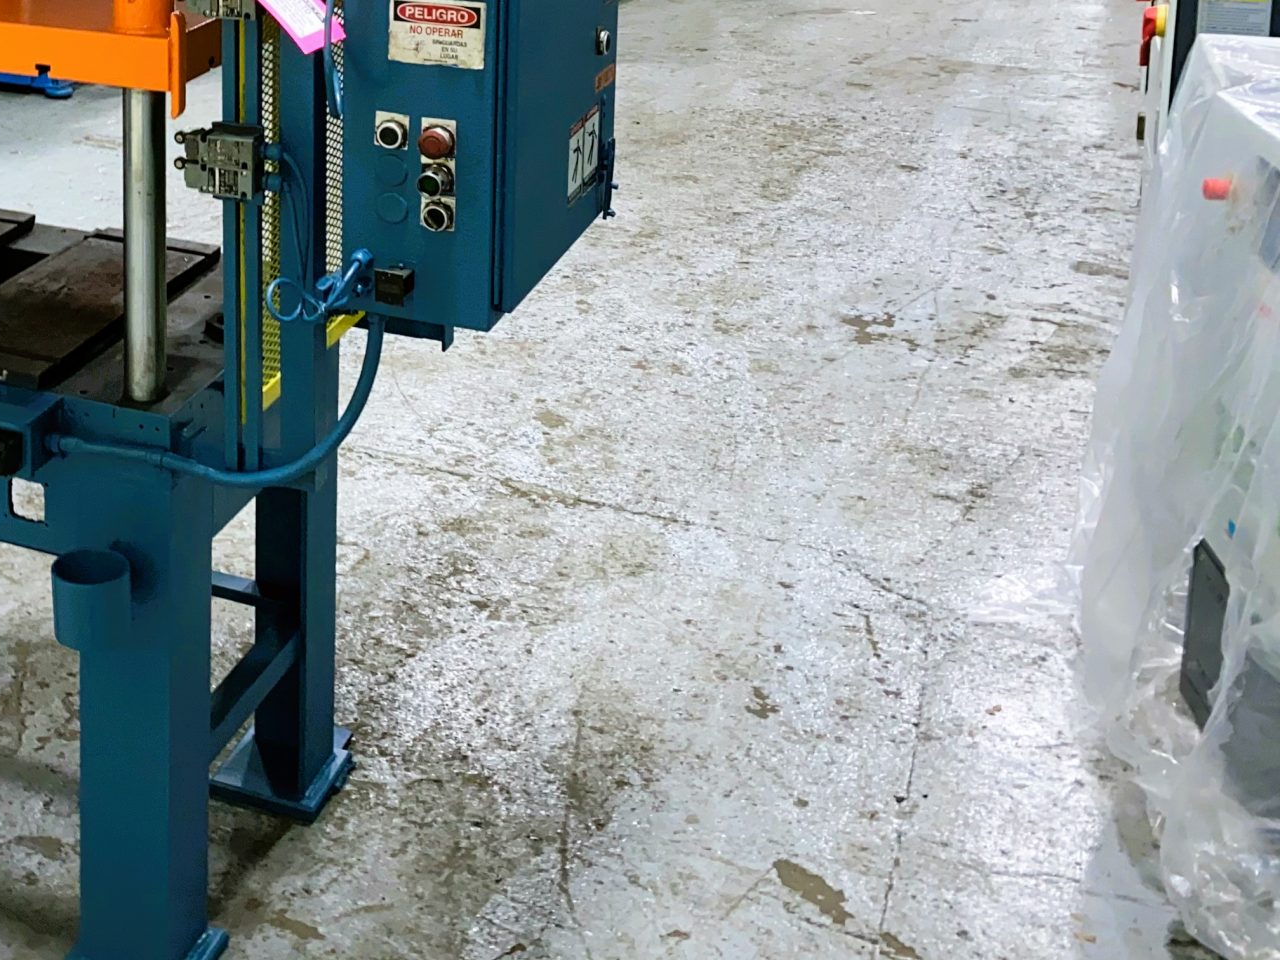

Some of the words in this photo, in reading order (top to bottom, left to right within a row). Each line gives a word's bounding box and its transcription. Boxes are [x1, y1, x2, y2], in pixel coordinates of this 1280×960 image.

[405, 6, 469, 23] PELIGRO
[409, 25, 423, 35] NO
[425, 27, 464, 39] OPERAR
